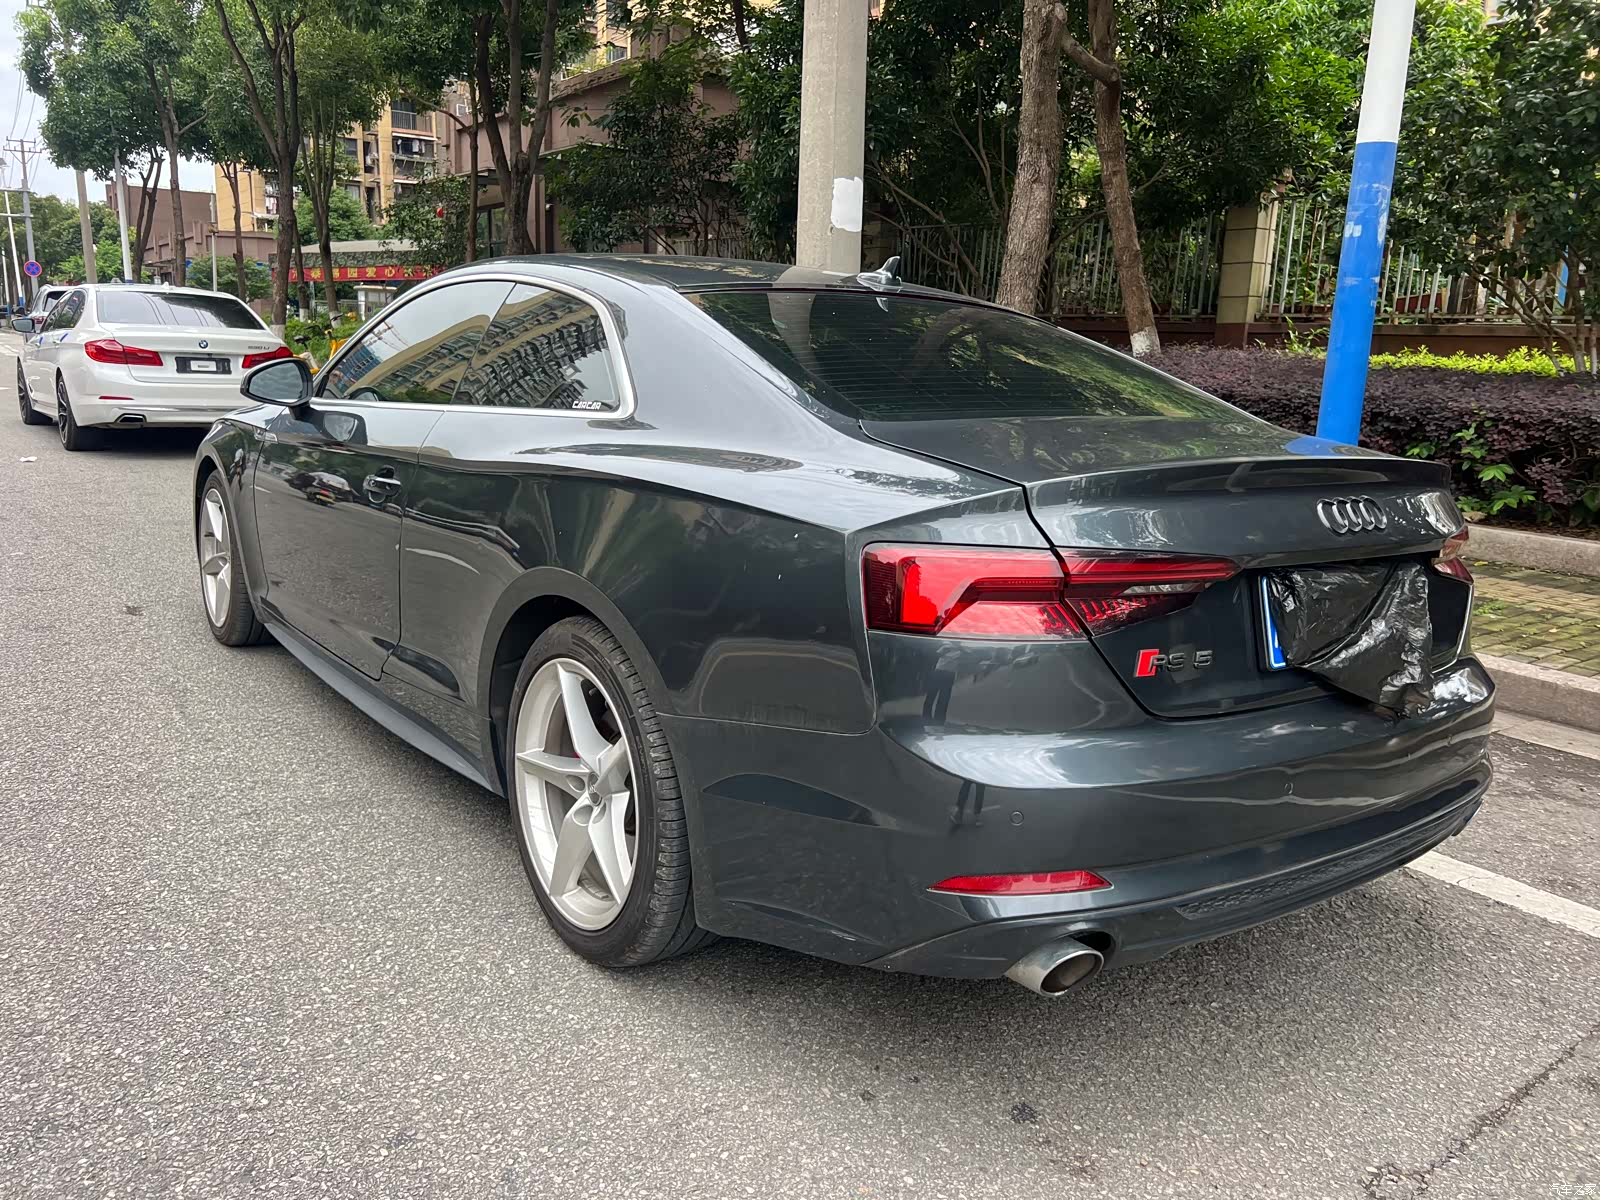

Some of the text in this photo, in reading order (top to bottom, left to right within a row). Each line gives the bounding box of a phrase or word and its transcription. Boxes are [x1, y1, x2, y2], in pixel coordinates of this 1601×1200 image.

[572, 400, 602, 410] CARCAR
[1140, 649, 1213, 675] RS 5
